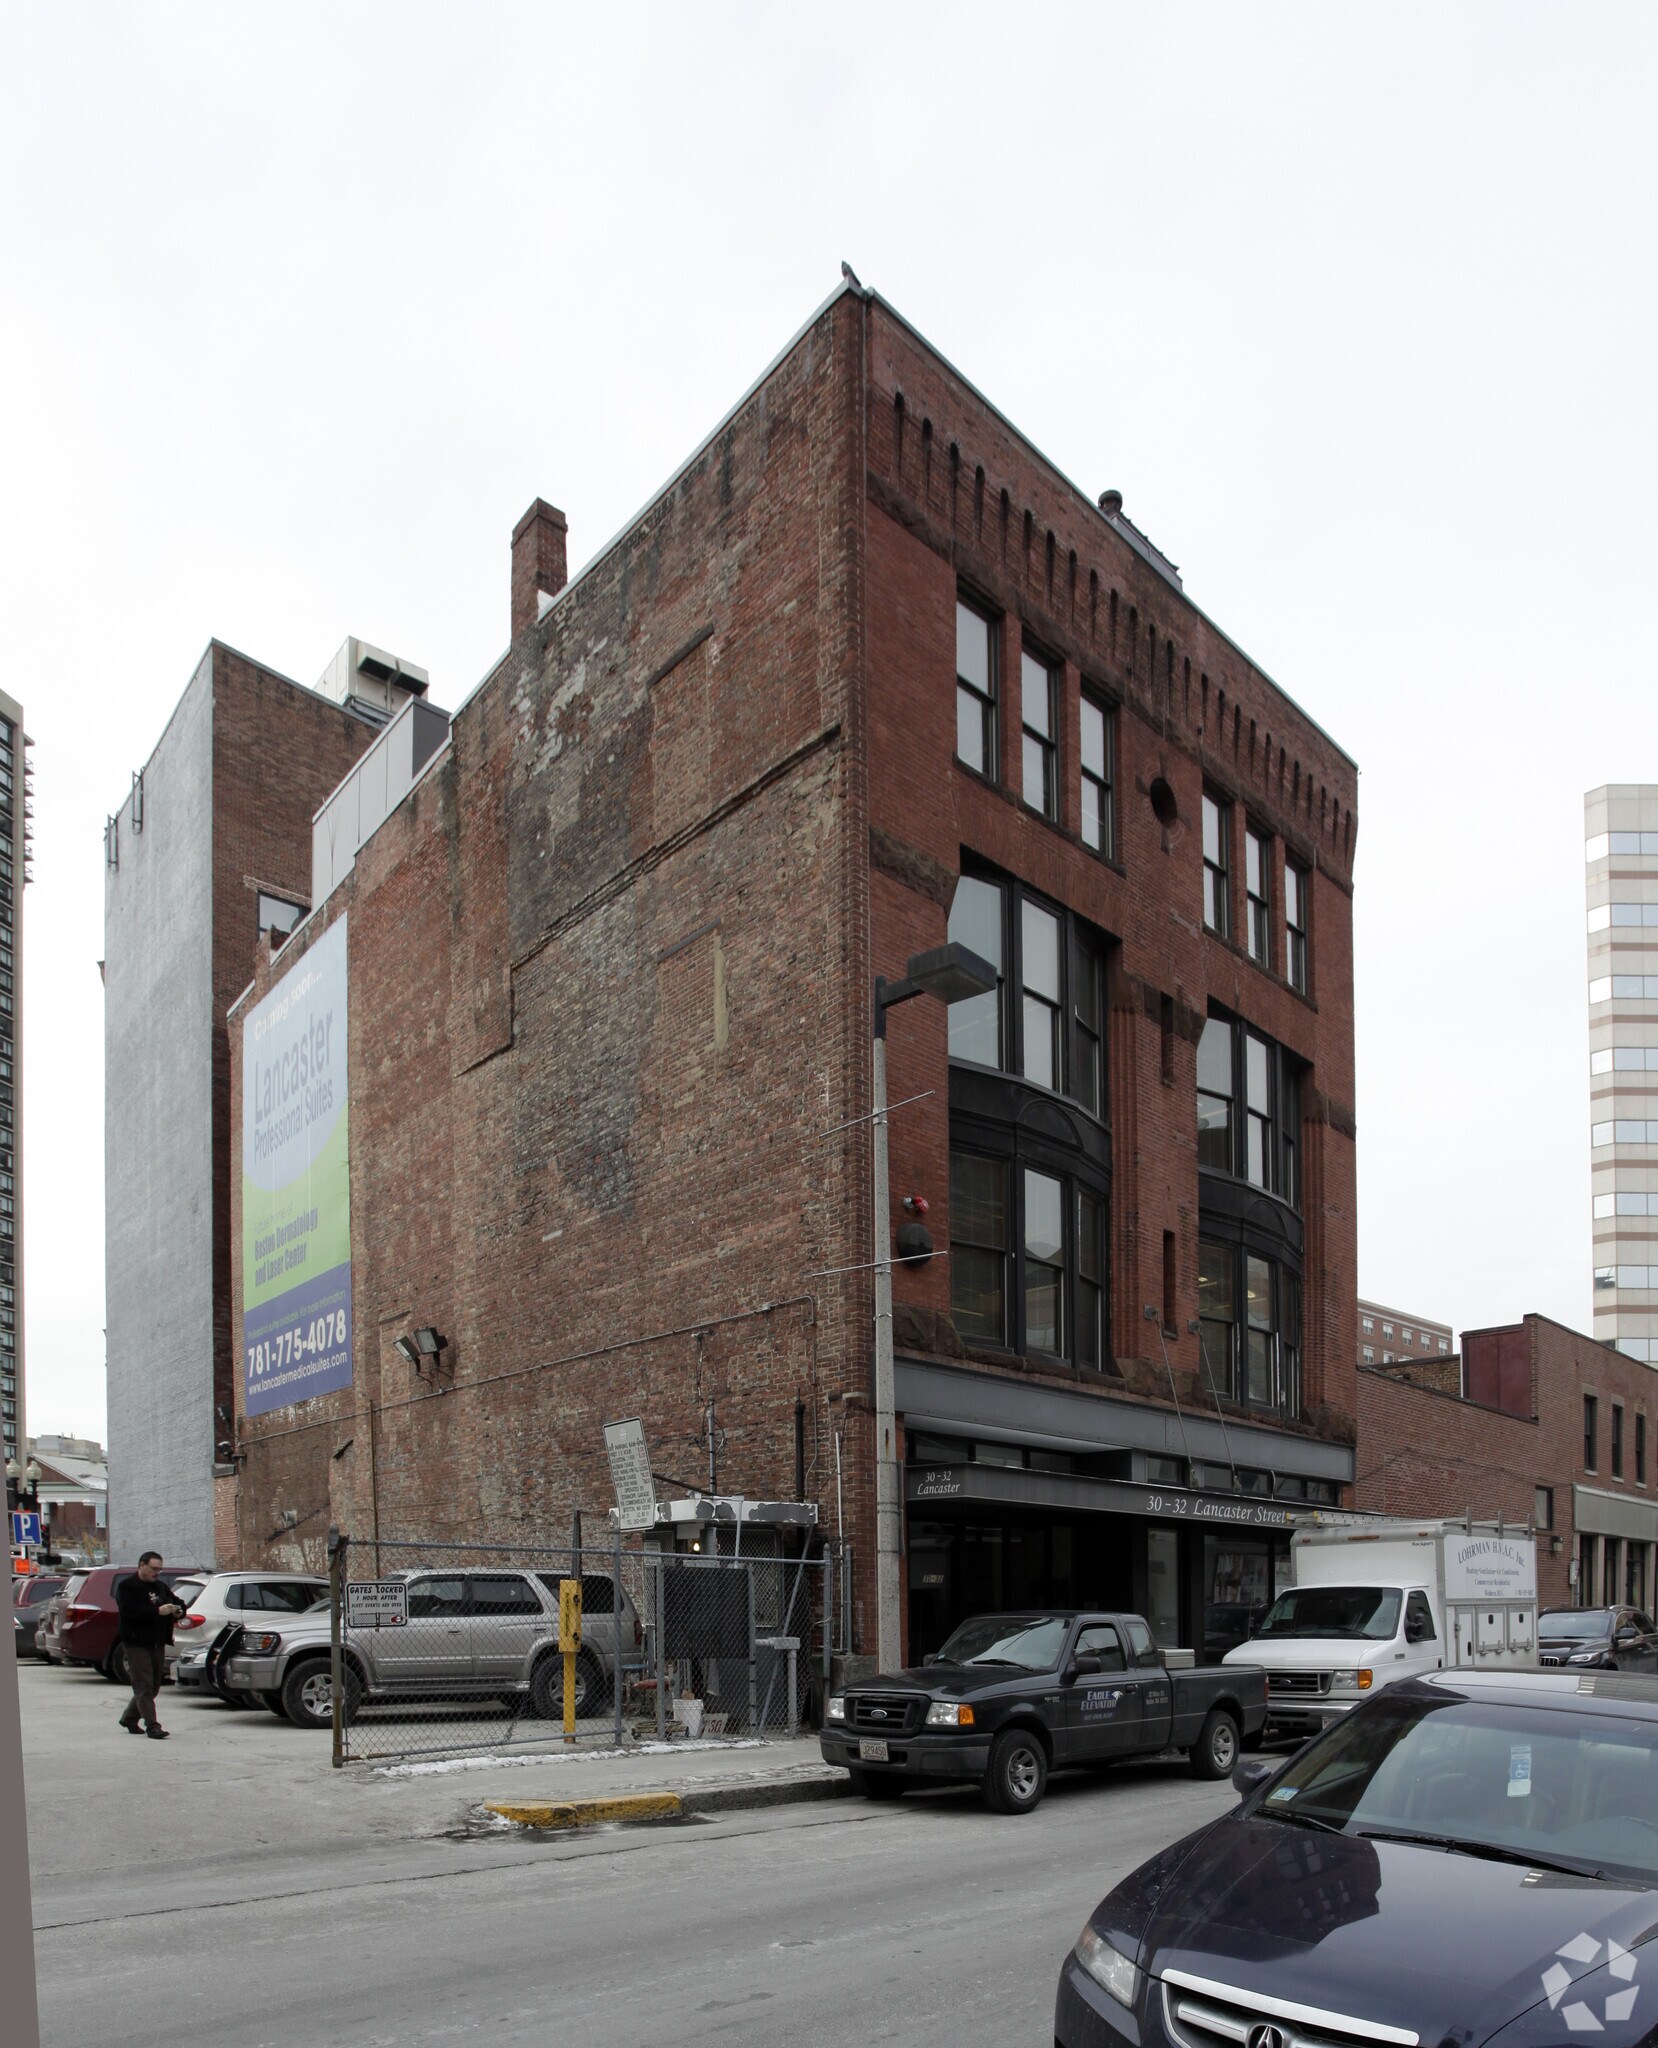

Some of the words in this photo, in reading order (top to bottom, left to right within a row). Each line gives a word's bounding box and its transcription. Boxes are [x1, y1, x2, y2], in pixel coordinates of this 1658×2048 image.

[255, 996, 289, 1040] Coming
[255, 1008, 333, 1125] Lancaster
[254, 1091, 303, 1166] Professional
[304, 1078, 333, 1126] Suites
[255, 1233, 276, 1261] Boston
[276, 1206, 318, 1249] Dermatology
[255, 1261, 266, 1287] and
[267, 1256, 283, 1281] Laser
[285, 1242, 307, 1271] Center
[248, 1309, 346, 1378] 781-775-4078
[248, 1351, 347, 1395] www.lancastermedicalsuites.com
[917, 1483, 960, 1495] Lancaster
[1193, 1499, 1252, 1520] Lancaster
[1255, 1505, 1286, 1523] Street
[1458, 1541, 1490, 1565] LOHRMAN
[350, 1586, 372, 1594] GATES
[377, 1586, 403, 1594] LOCKED
[1080, 1699, 1117, 1710] ELEVATOR
[1087, 1691, 1110, 1701] EAGLE
